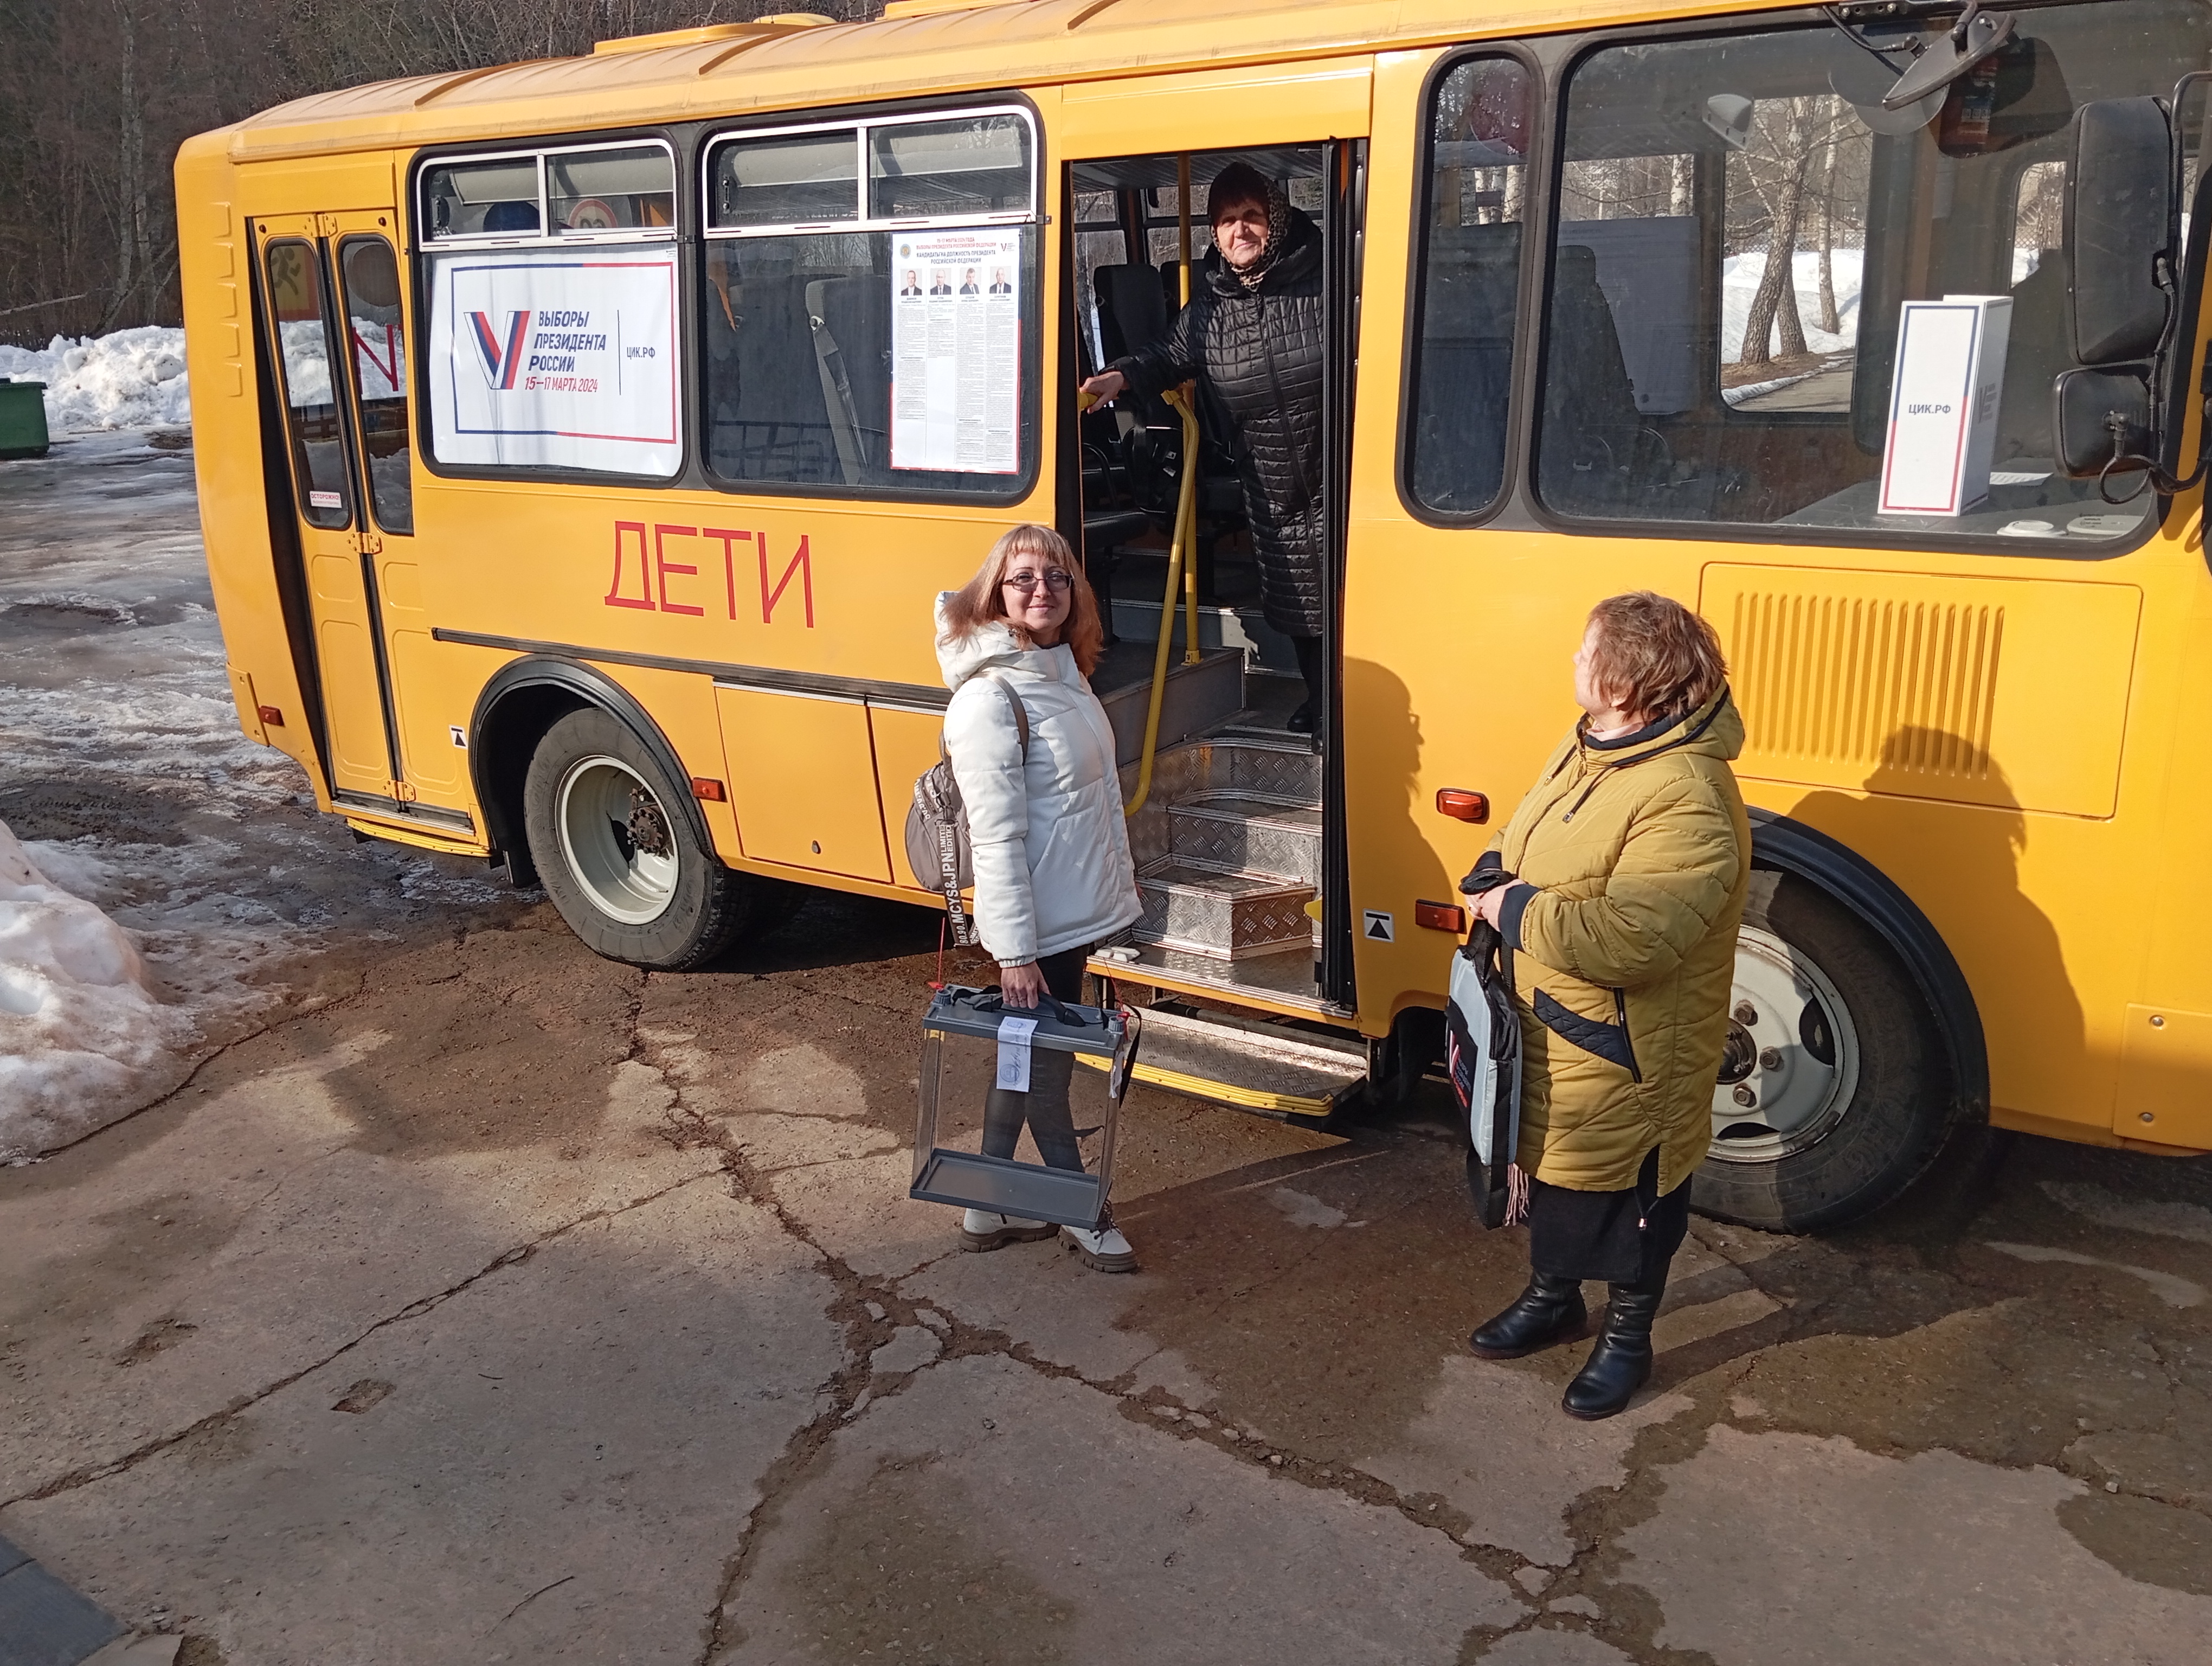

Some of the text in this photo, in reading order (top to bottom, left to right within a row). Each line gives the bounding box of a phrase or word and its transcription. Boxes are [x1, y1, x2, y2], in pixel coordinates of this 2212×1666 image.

[538, 311, 590, 328] ВЫБОРЫ
[534, 333, 607, 352] ПРЕЗИДЕНТА
[627, 346, 655, 359] ЦИК.РФ
[529, 355, 575, 372] РОССИИ
[552, 377, 577, 392] МАРТА
[578, 379, 598, 393] 2024
[1908, 403, 1951, 415] ЦИК.РФ
[605, 521, 814, 628] ДЕТИ
